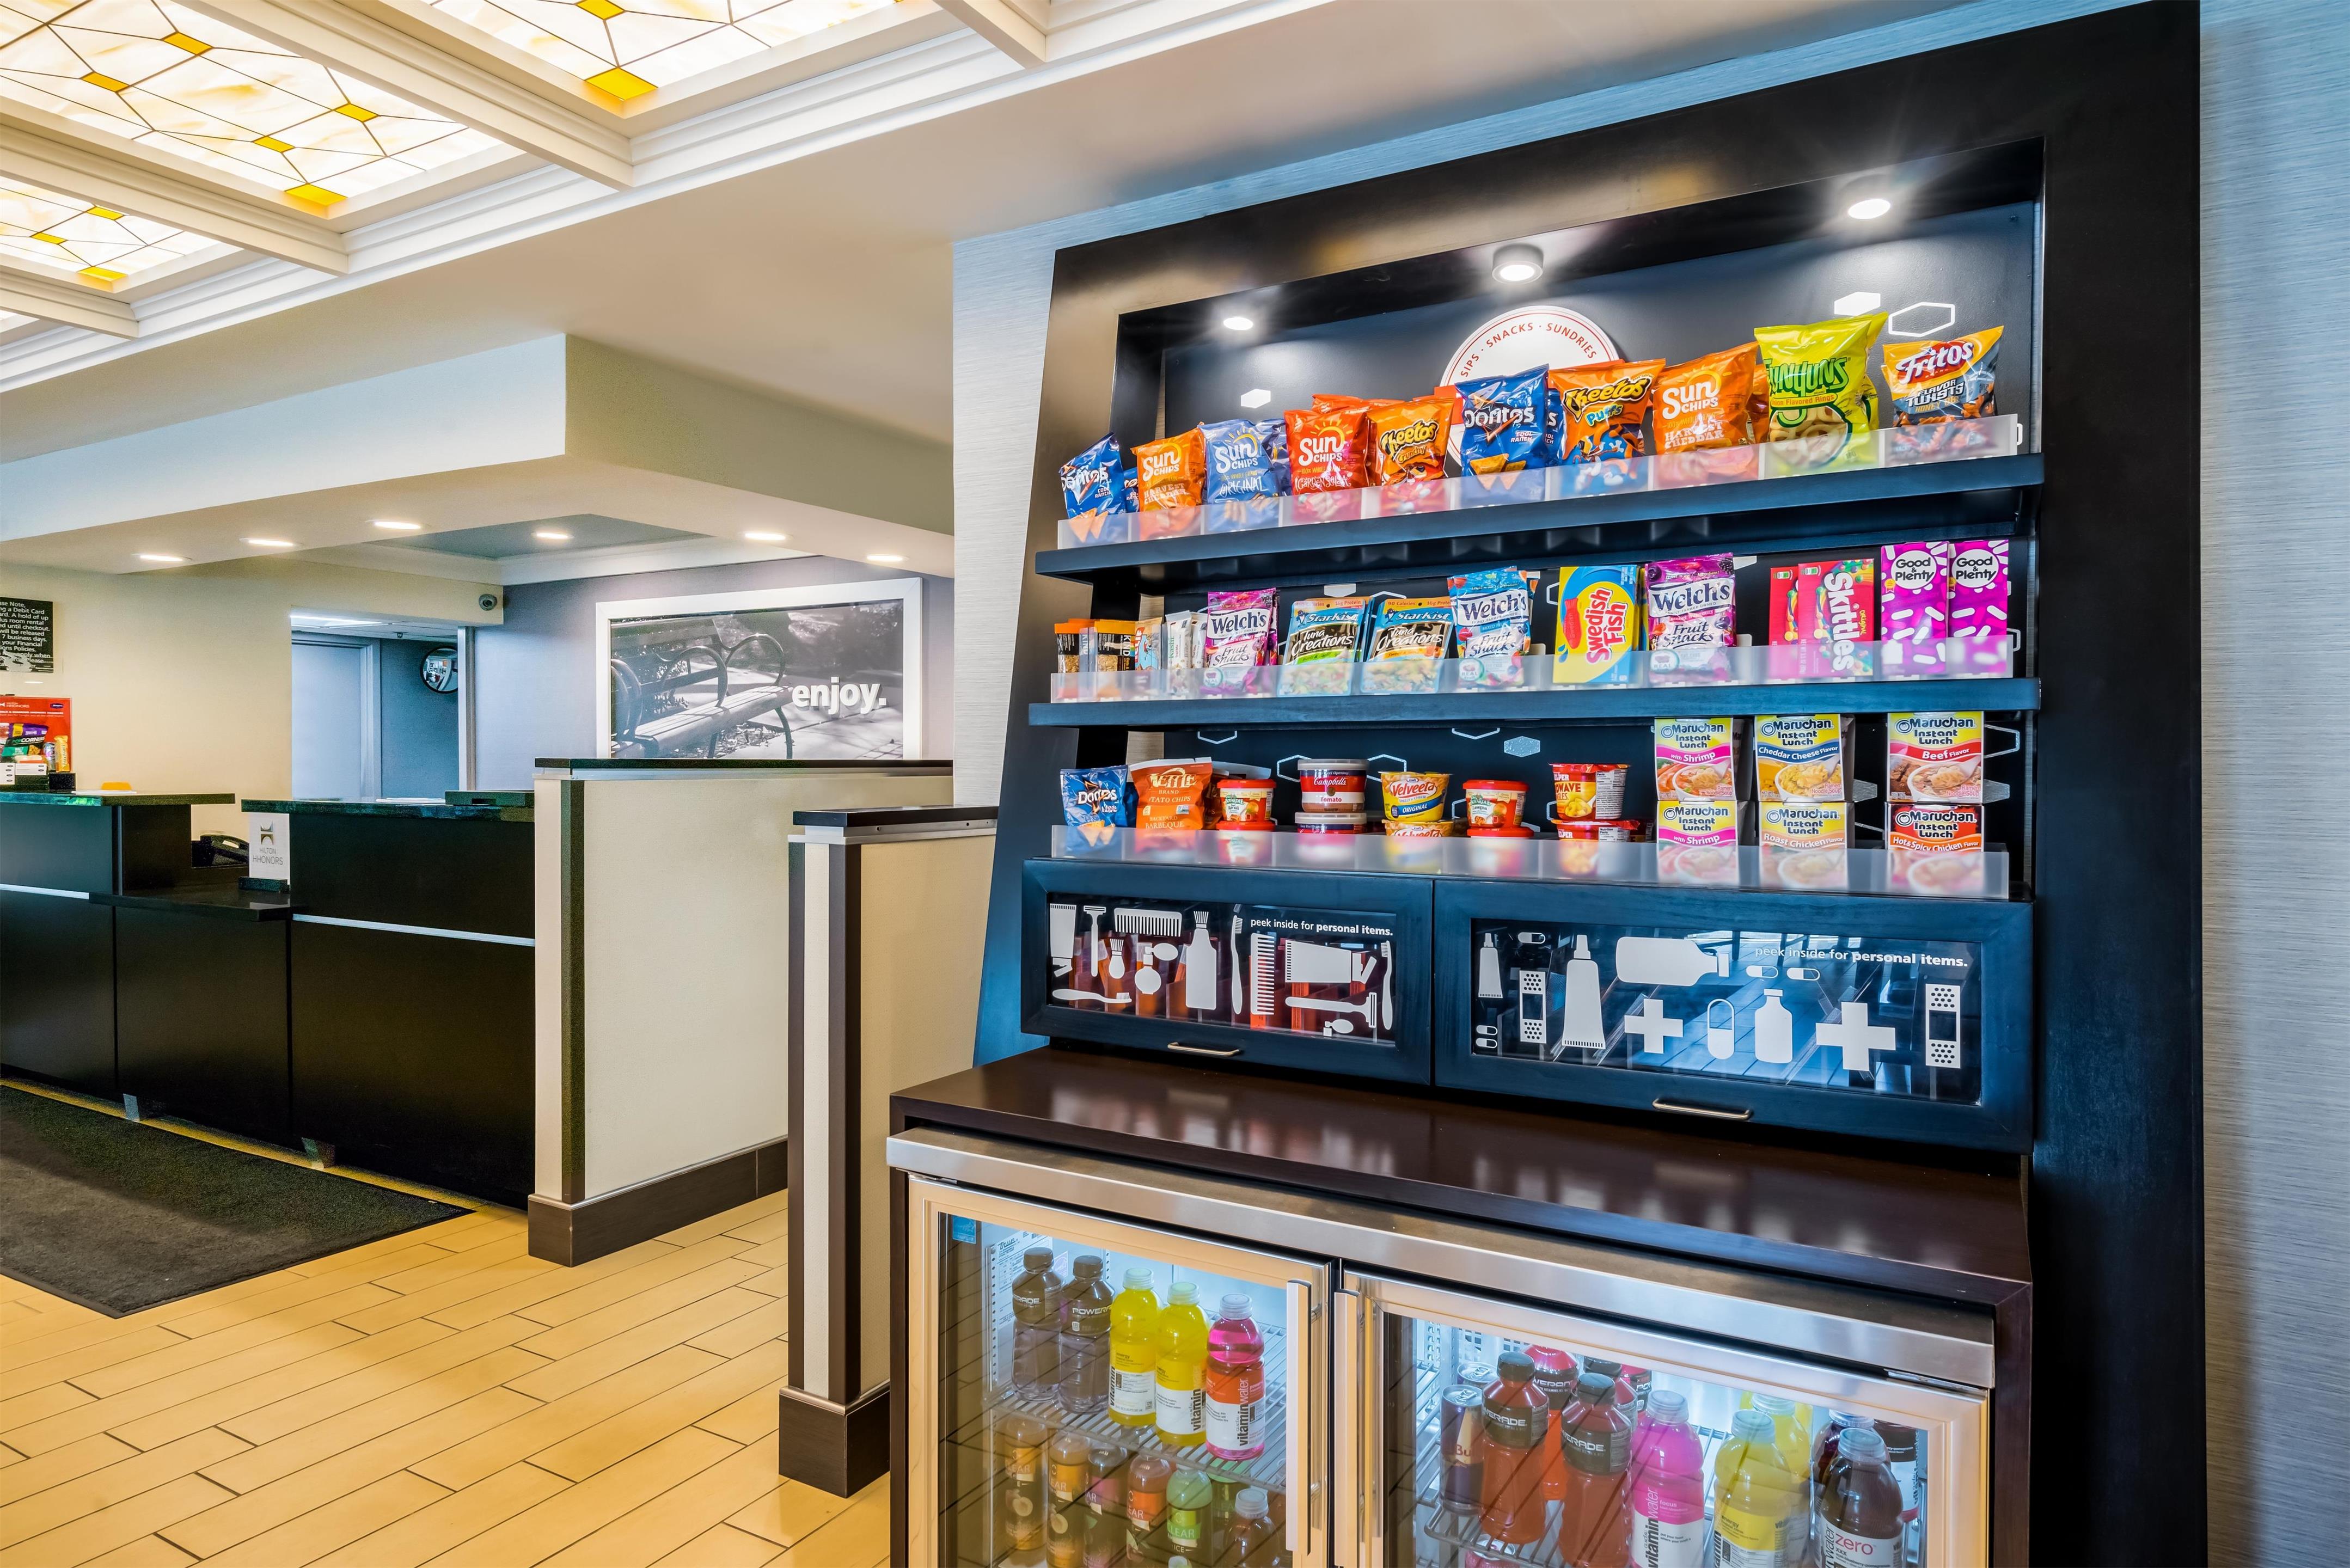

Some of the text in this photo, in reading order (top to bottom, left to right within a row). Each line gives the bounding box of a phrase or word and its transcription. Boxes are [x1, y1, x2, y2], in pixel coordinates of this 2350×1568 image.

[1461, 322, 1597, 377] SIPS SNACKS SUNDRIES
[1895, 342, 1974, 384] Fritos
[1918, 379, 1956, 396] FLAVOR
[1564, 378, 1650, 421] Cheetos
[1662, 381, 1721, 419] Sun
[1815, 394, 1834, 403] Rings
[1906, 382, 1965, 407] TWISTS
[1681, 397, 1718, 413] CHIPS
[1464, 407, 1534, 428] Doritos
[1664, 431, 1724, 449] CHEDDAR
[1299, 437, 1344, 466] Sun
[1313, 453, 1343, 463] CHIPS
[1215, 444, 1258, 473] Sun
[1232, 458, 1258, 469] CHIPS
[1143, 451, 1180, 481] Sun
[1154, 464, 1179, 476] CHIPS
[1896, 558, 1931, 568] Good
[1956, 556, 1993, 567] Good
[1895, 571, 1935, 581] Plenty
[1956, 570, 1997, 580] Plenty
[1461, 593, 1526, 621] Welch's
[1211, 611, 1267, 634] Welch's
[1396, 612, 1451, 620] StarKist
[1824, 572, 1861, 671] Skittles
[1586, 589, 1611, 663] Swedish
[1604, 603, 1626, 646] Fish
[1673, 621, 1709, 635] Fruit
[1300, 629, 1325, 641] Tuna
[1388, 627, 1413, 638] Tuna
[1480, 632, 1511, 645] Fruit
[1292, 635, 1354, 656] Creations
[1377, 632, 1445, 651] Creations
[1222, 644, 1248, 656] Fruit
[1213, 653, 1249, 666] Snacks
[792, 676, 887, 715] enjoy.
[1672, 724, 1723, 733] Maruchan
[1773, 719, 1831, 730] Maruchan
[1910, 718, 1973, 728] Maruchan
[1778, 731, 1817, 739] Instant
[1684, 752, 1715, 762] Shrimp
[1759, 747, 1790, 759] Cheddar
[1792, 750, 1820, 759] Cheese
[1922, 749, 1970, 759] Beef Flavor
[1392, 781, 1435, 797] Velveeta
[1403, 804, 1428, 813] ORIGINAL
[1675, 807, 1728, 816] Maruchan
[1779, 809, 1837, 819] Maruchan
[1910, 811, 1973, 822] Maruchan
[1146, 821, 1185, 829] BARBEQUE
[1687, 835, 1720, 844] Shrimp
[1764, 833, 1789, 845] Roast
[1790, 838, 1826, 848] Chicken
[1932, 843, 1962, 851] Chicken
[253, 855, 283, 865] HHONORS
[1251, 918, 1393, 936] peek inside for personal items.
[1755, 947, 1968, 967] peek inside for personal items.
[1835, 1533, 1874, 1555] zero
